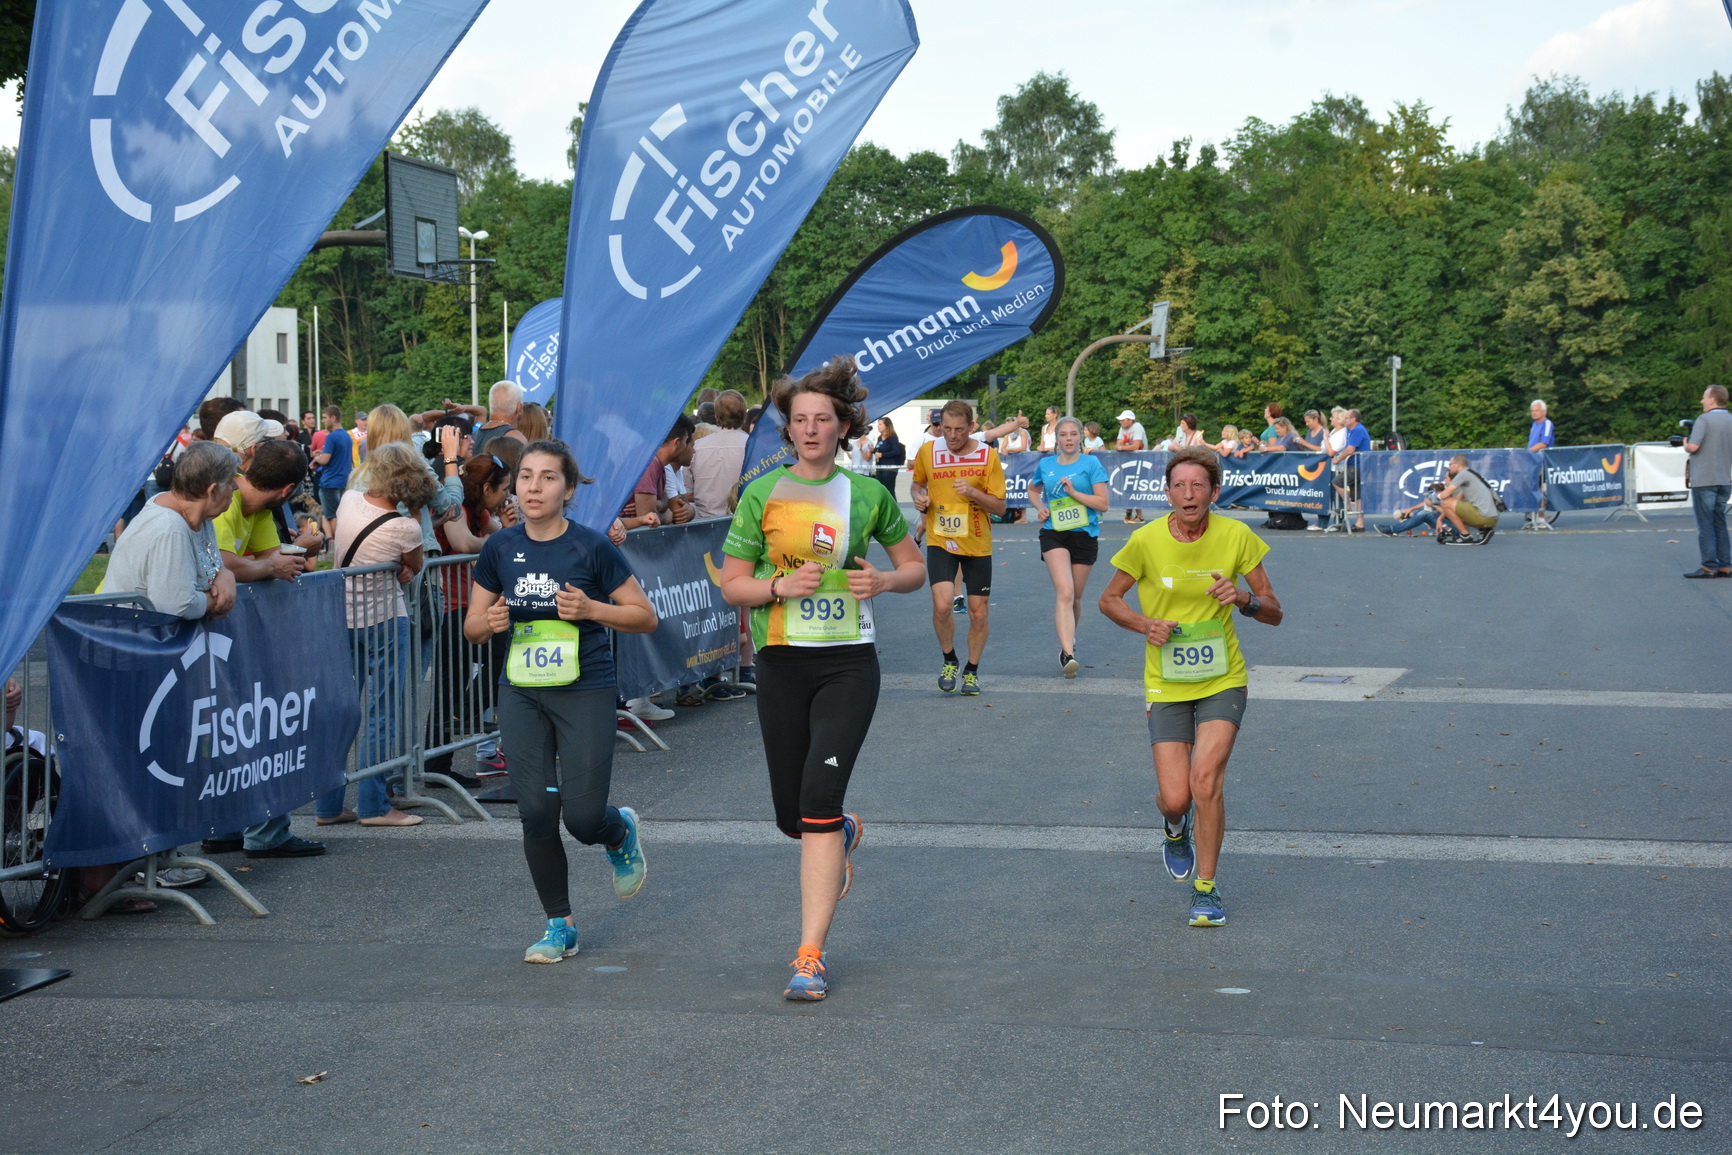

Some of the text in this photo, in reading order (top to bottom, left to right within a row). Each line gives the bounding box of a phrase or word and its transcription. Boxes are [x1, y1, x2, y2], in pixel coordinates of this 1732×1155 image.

[164, 0, 339, 159] Fis
[654, 0, 839, 256] Fischer
[720, 43, 863, 252] AUTOMOBILE
[915, 283, 1046, 360] Druck und Medien
[850, 295, 982, 373] chmann
[545, 355, 558, 380] AUT
[933, 467, 988, 480] MAX BÖGL
[1222, 469, 1299, 487] Frischmann
[1547, 466, 1605, 485] Frischmann
[1128, 493, 1169, 502] AUTOMO
[1265, 486, 1285, 496] Druck
[1286, 487, 1298, 497] und
[939, 515, 962, 529] 910
[1057, 507, 1080, 522] 808
[516, 578, 558, 597] Burgis
[531, 599, 557, 610] guad
[800, 597, 845, 621] 993
[701, 612, 719, 634] und
[522, 646, 564, 669] 164
[1172, 644, 1214, 666] 599
[187, 681, 317, 764] Fischer
[198, 744, 307, 801] AUTOMOBILE
